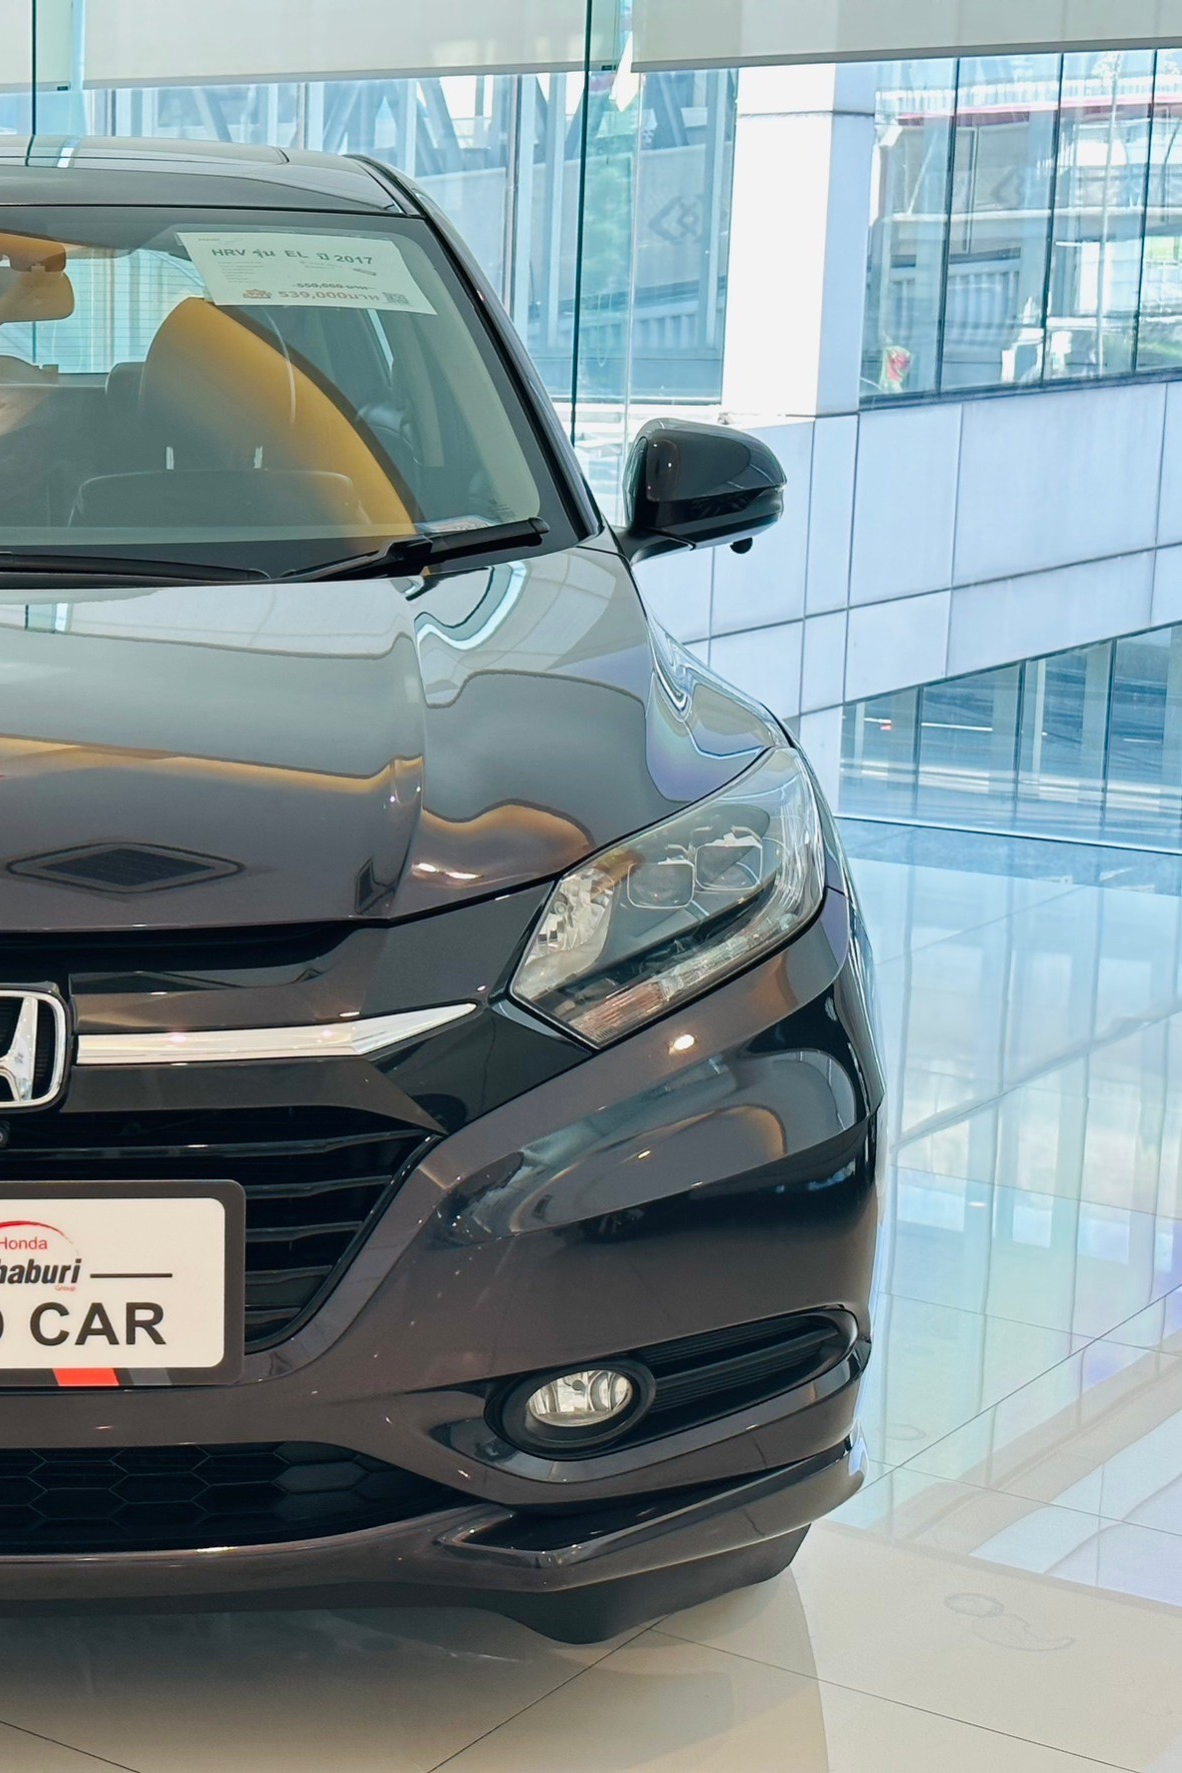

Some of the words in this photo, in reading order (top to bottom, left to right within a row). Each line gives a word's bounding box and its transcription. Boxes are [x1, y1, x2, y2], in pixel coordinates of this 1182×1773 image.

[211, 248, 246, 257] HRV
[284, 249, 309, 259] EL
[335, 253, 374, 265] 2017
[29, 1301, 167, 1346] CAR
